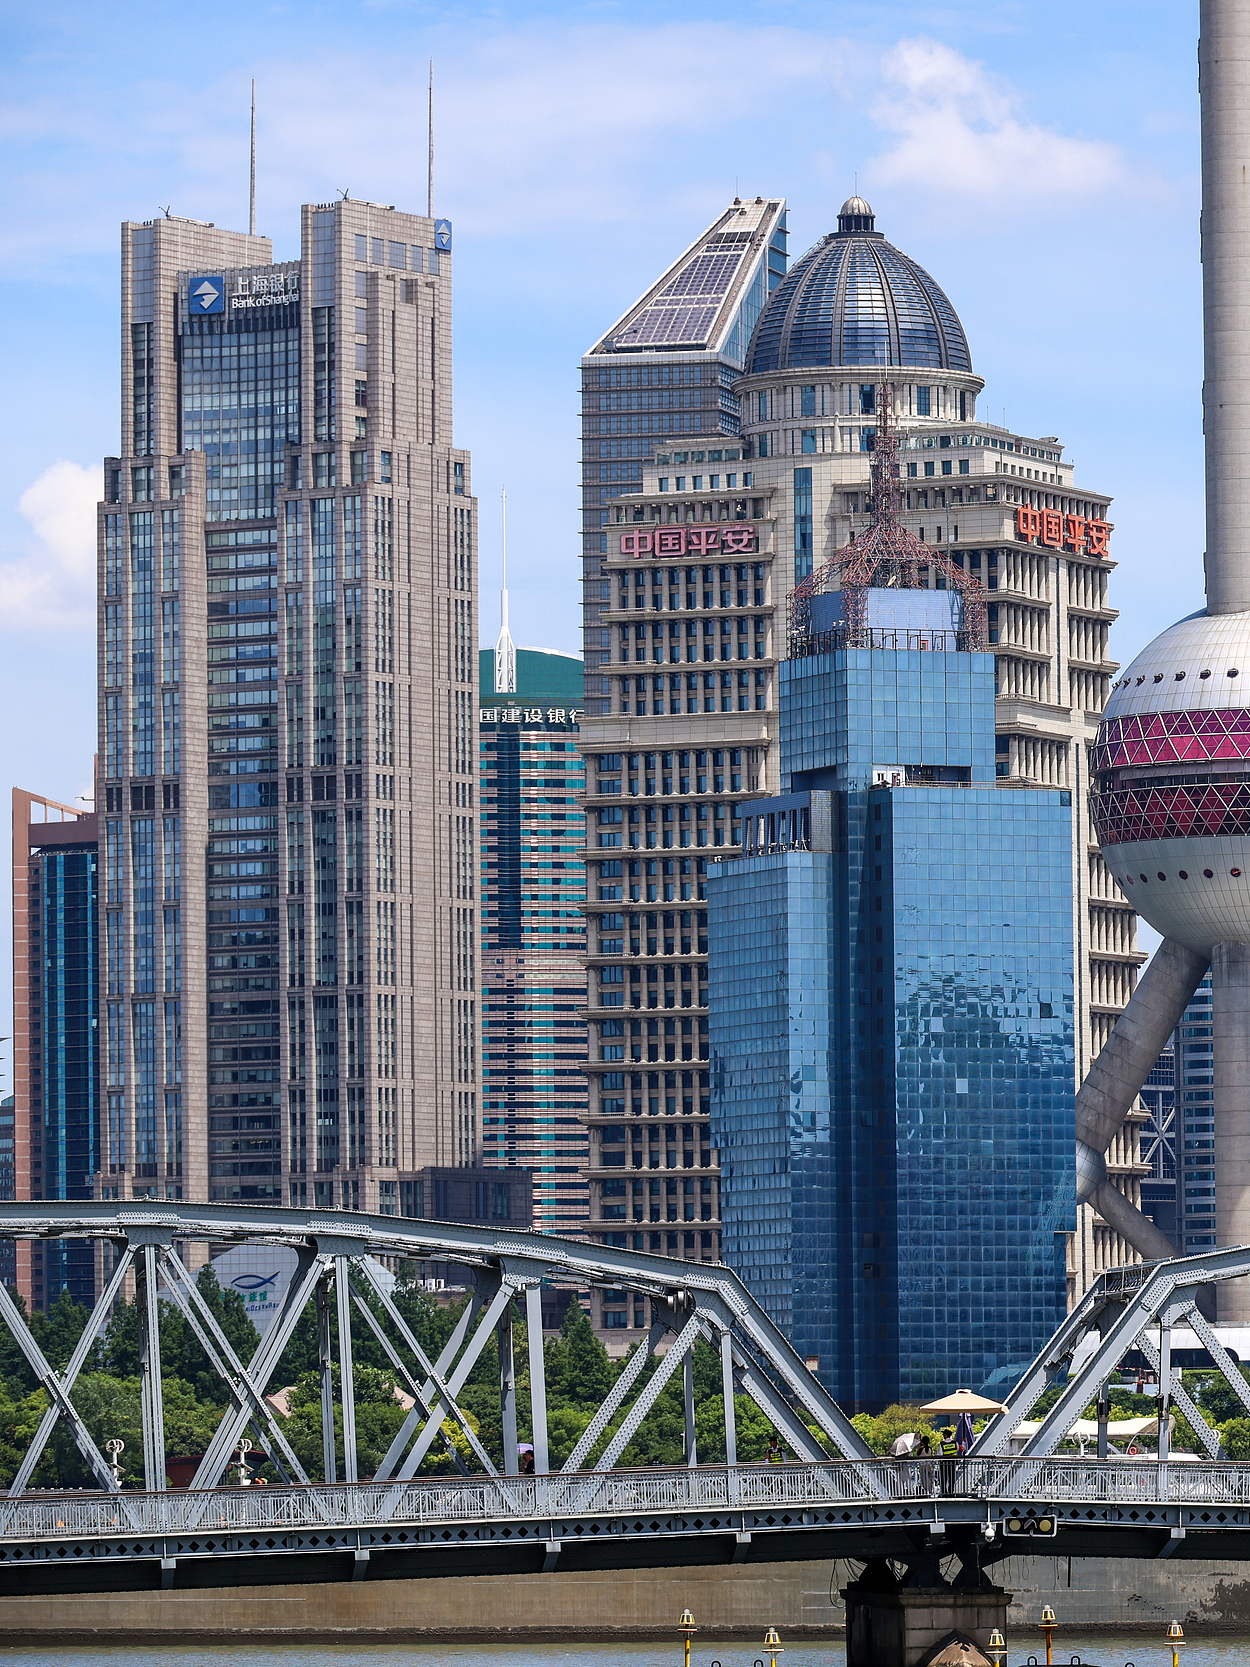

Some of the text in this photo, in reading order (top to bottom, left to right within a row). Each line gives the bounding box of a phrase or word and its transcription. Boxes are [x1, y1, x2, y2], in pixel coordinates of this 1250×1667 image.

[231, 270, 299, 296] 上海银行
[231, 297, 256, 309] Bank
[620, 524, 755, 558] 中国平安
[1018, 503, 1109, 557] 中国平安
